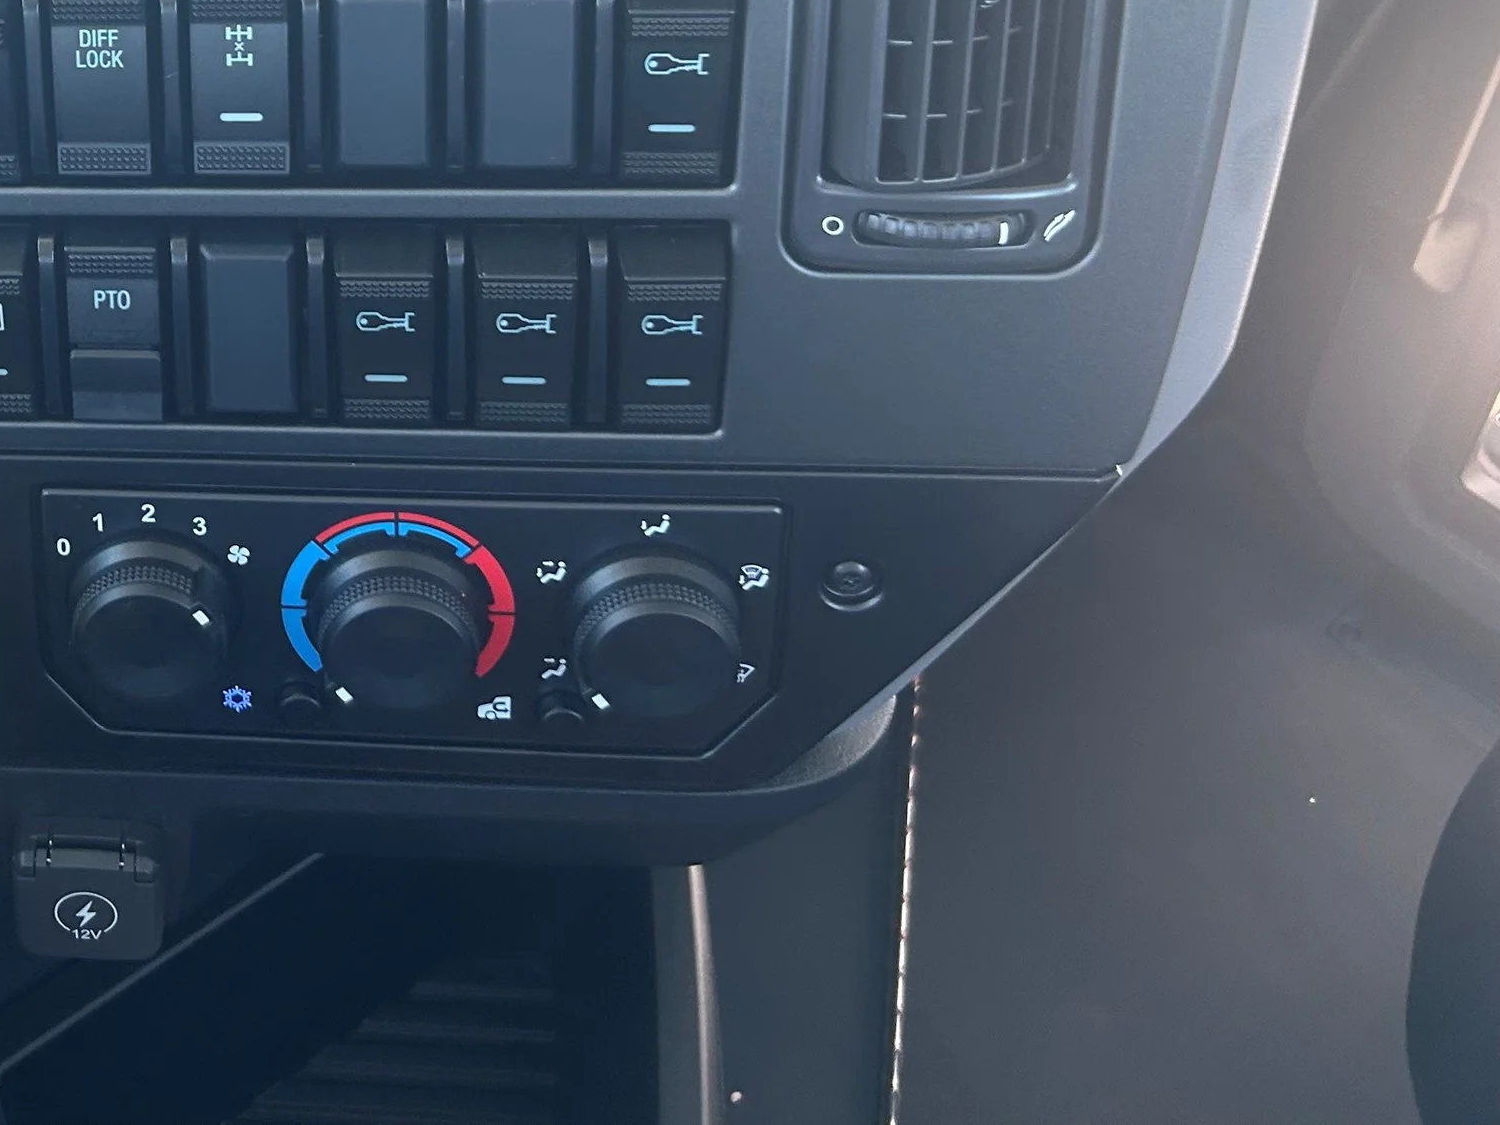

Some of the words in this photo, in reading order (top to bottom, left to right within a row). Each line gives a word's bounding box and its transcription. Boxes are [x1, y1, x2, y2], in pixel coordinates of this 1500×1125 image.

[79, 29, 118, 48] DIFF
[75, 49, 124, 69] LOCK
[93, 289, 131, 310] PTO
[92, 512, 104, 532] 1
[141, 503, 156, 523] 2
[192, 516, 207, 536] 3
[56, 537, 71, 556] 0
[72, 929, 102, 940] 12V
